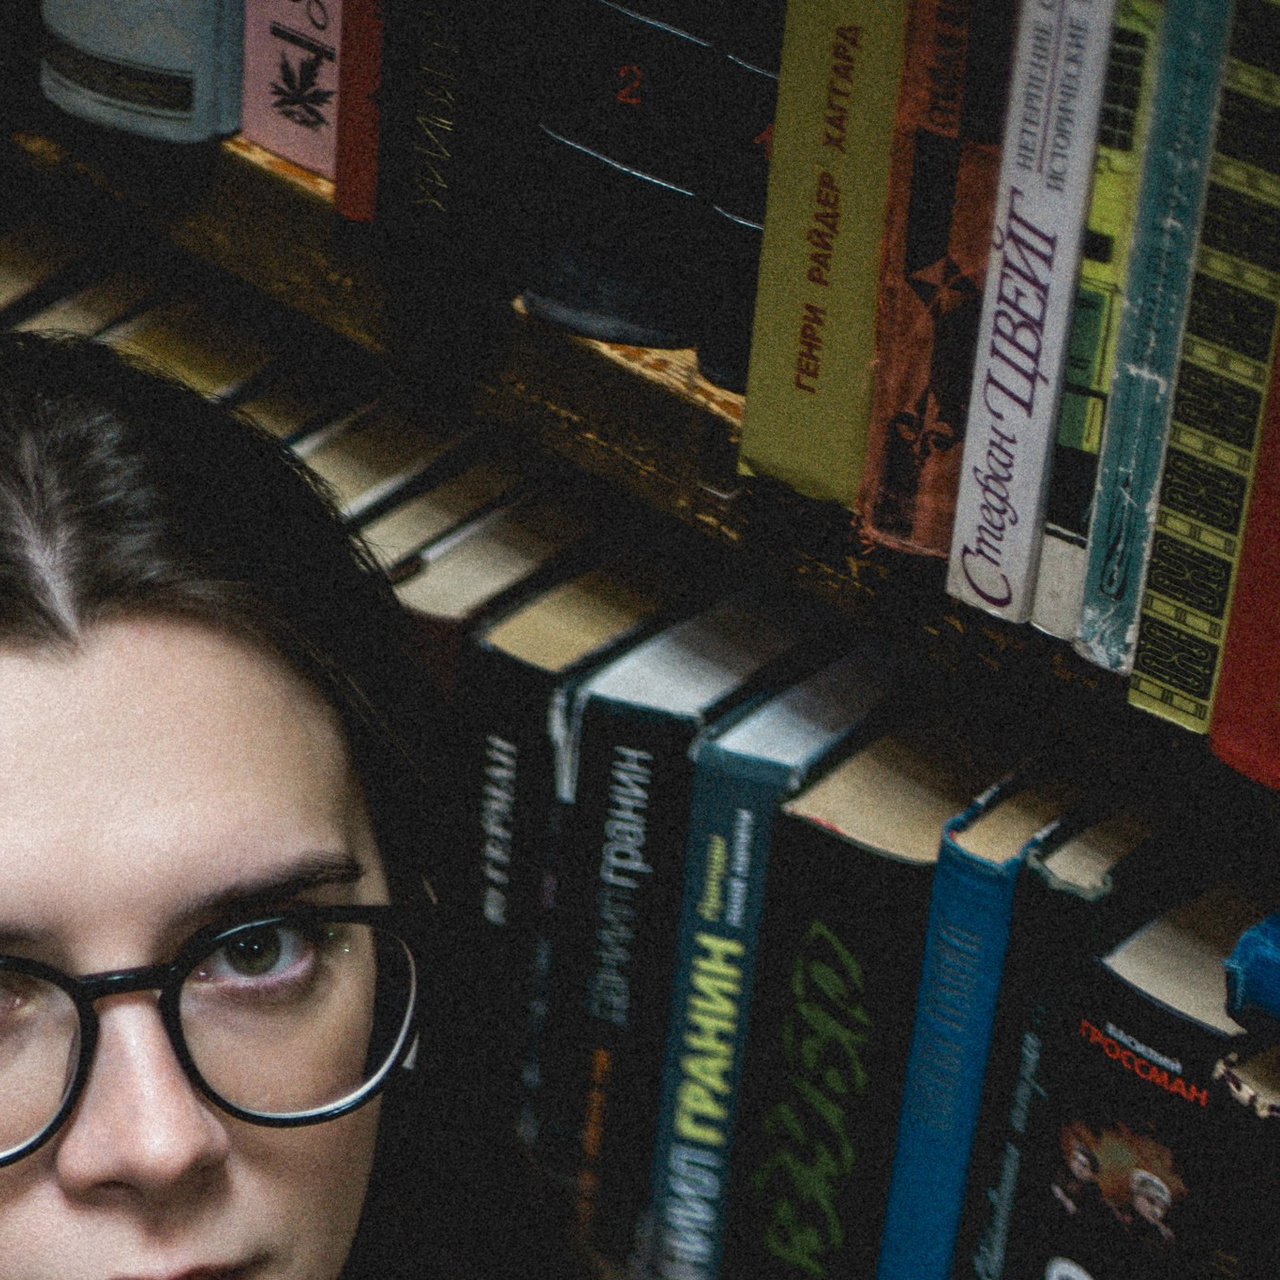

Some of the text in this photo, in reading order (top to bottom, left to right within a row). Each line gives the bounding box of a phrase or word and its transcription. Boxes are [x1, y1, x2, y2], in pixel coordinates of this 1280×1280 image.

[616, 65, 643, 105] 2
[1016, 12, 1053, 171] НЕТЕРПЕНИЕ
[1046, 18, 1090, 193] ИСТОРИЧЕСКИЕ
[794, 24, 862, 395] ГЕНРИ РАЙДЕР ХАГГАРД
[965, 186, 1059, 610] Стефан ЦВЕЙГ
[674, 932, 745, 1147] ГРАНИН
[1080, 1017, 1210, 1108] ГРОССМАН
